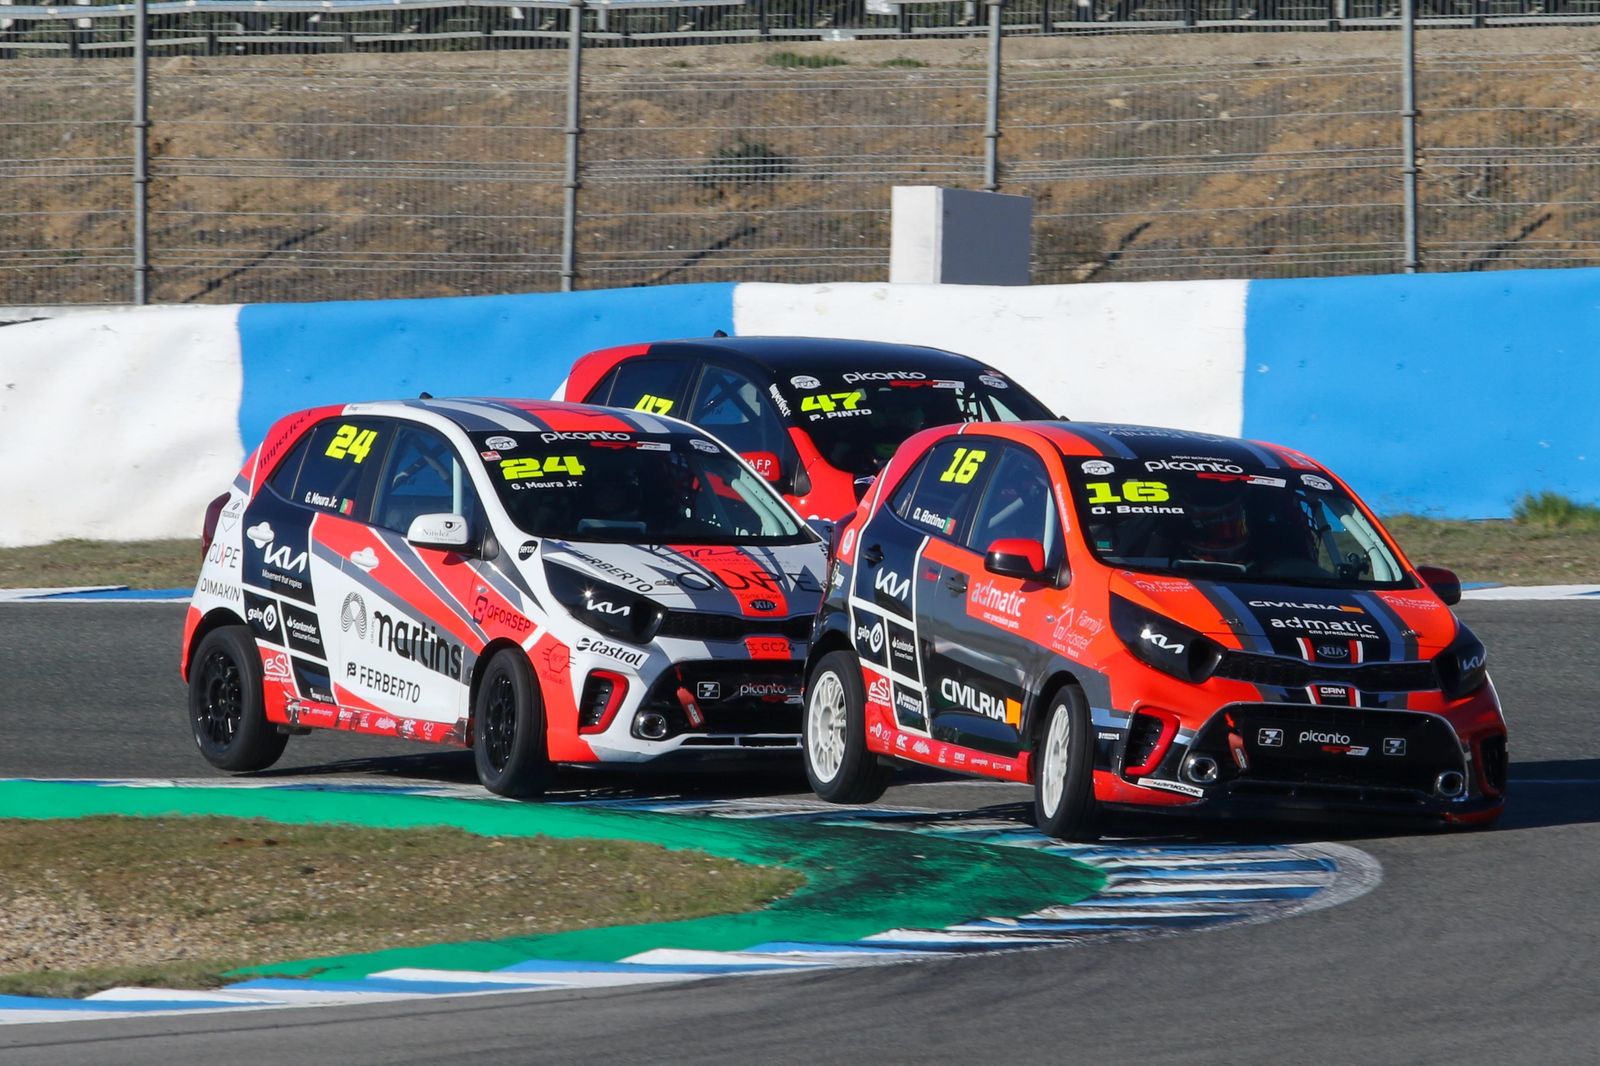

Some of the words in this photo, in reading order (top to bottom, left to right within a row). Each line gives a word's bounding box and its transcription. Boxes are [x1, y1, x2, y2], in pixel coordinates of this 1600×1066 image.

[842, 371, 926, 384] picanto
[801, 392, 861, 412] 47
[826, 408, 872, 418] PINTO
[325, 424, 378, 464] 24
[540, 431, 630, 443] picanto
[500, 455, 586, 480] 24
[940, 447, 986, 484] 16
[1144, 459, 1243, 473] picanto
[525, 480, 564, 489] Moura
[567, 479, 583, 487] Jr.
[1086, 481, 1169, 504] 16
[304, 491, 312, 503] G.
[311, 492, 330, 507] Moura
[328, 495, 338, 508] Jr.
[913, 507, 921, 520] O.
[920, 509, 946, 529] Batina
[1091, 506, 1111, 515] O.
[1116, 505, 1184, 514] Batina
[264, 542, 308, 574] KIA
[200, 577, 241, 602] DIMAKIN
[874, 567, 911, 601] KIA
[754, 600, 775, 609] KIA
[971, 579, 1026, 618] admatic
[1248, 600, 1344, 612] CIVILRIA
[248, 607, 262, 622] galp
[586, 599, 631, 617] KIA
[292, 619, 317, 635] Santander
[487, 604, 531, 633] OFORSEP
[1270, 616, 1376, 634] admatic
[856, 625, 870, 642] galp
[1140, 626, 1185, 654] KIA
[1324, 630, 1359, 638] precision
[1360, 632, 1380, 640] parts
[374, 610, 462, 683] martins
[589, 640, 643, 667] Castrol
[360, 665, 421, 704] FERBERTO
[740, 682, 786, 696] picanto
[1320, 687, 1346, 695] CRM
[940, 677, 1007, 724] CIVILRIA
[1299, 729, 1350, 745] picanto
